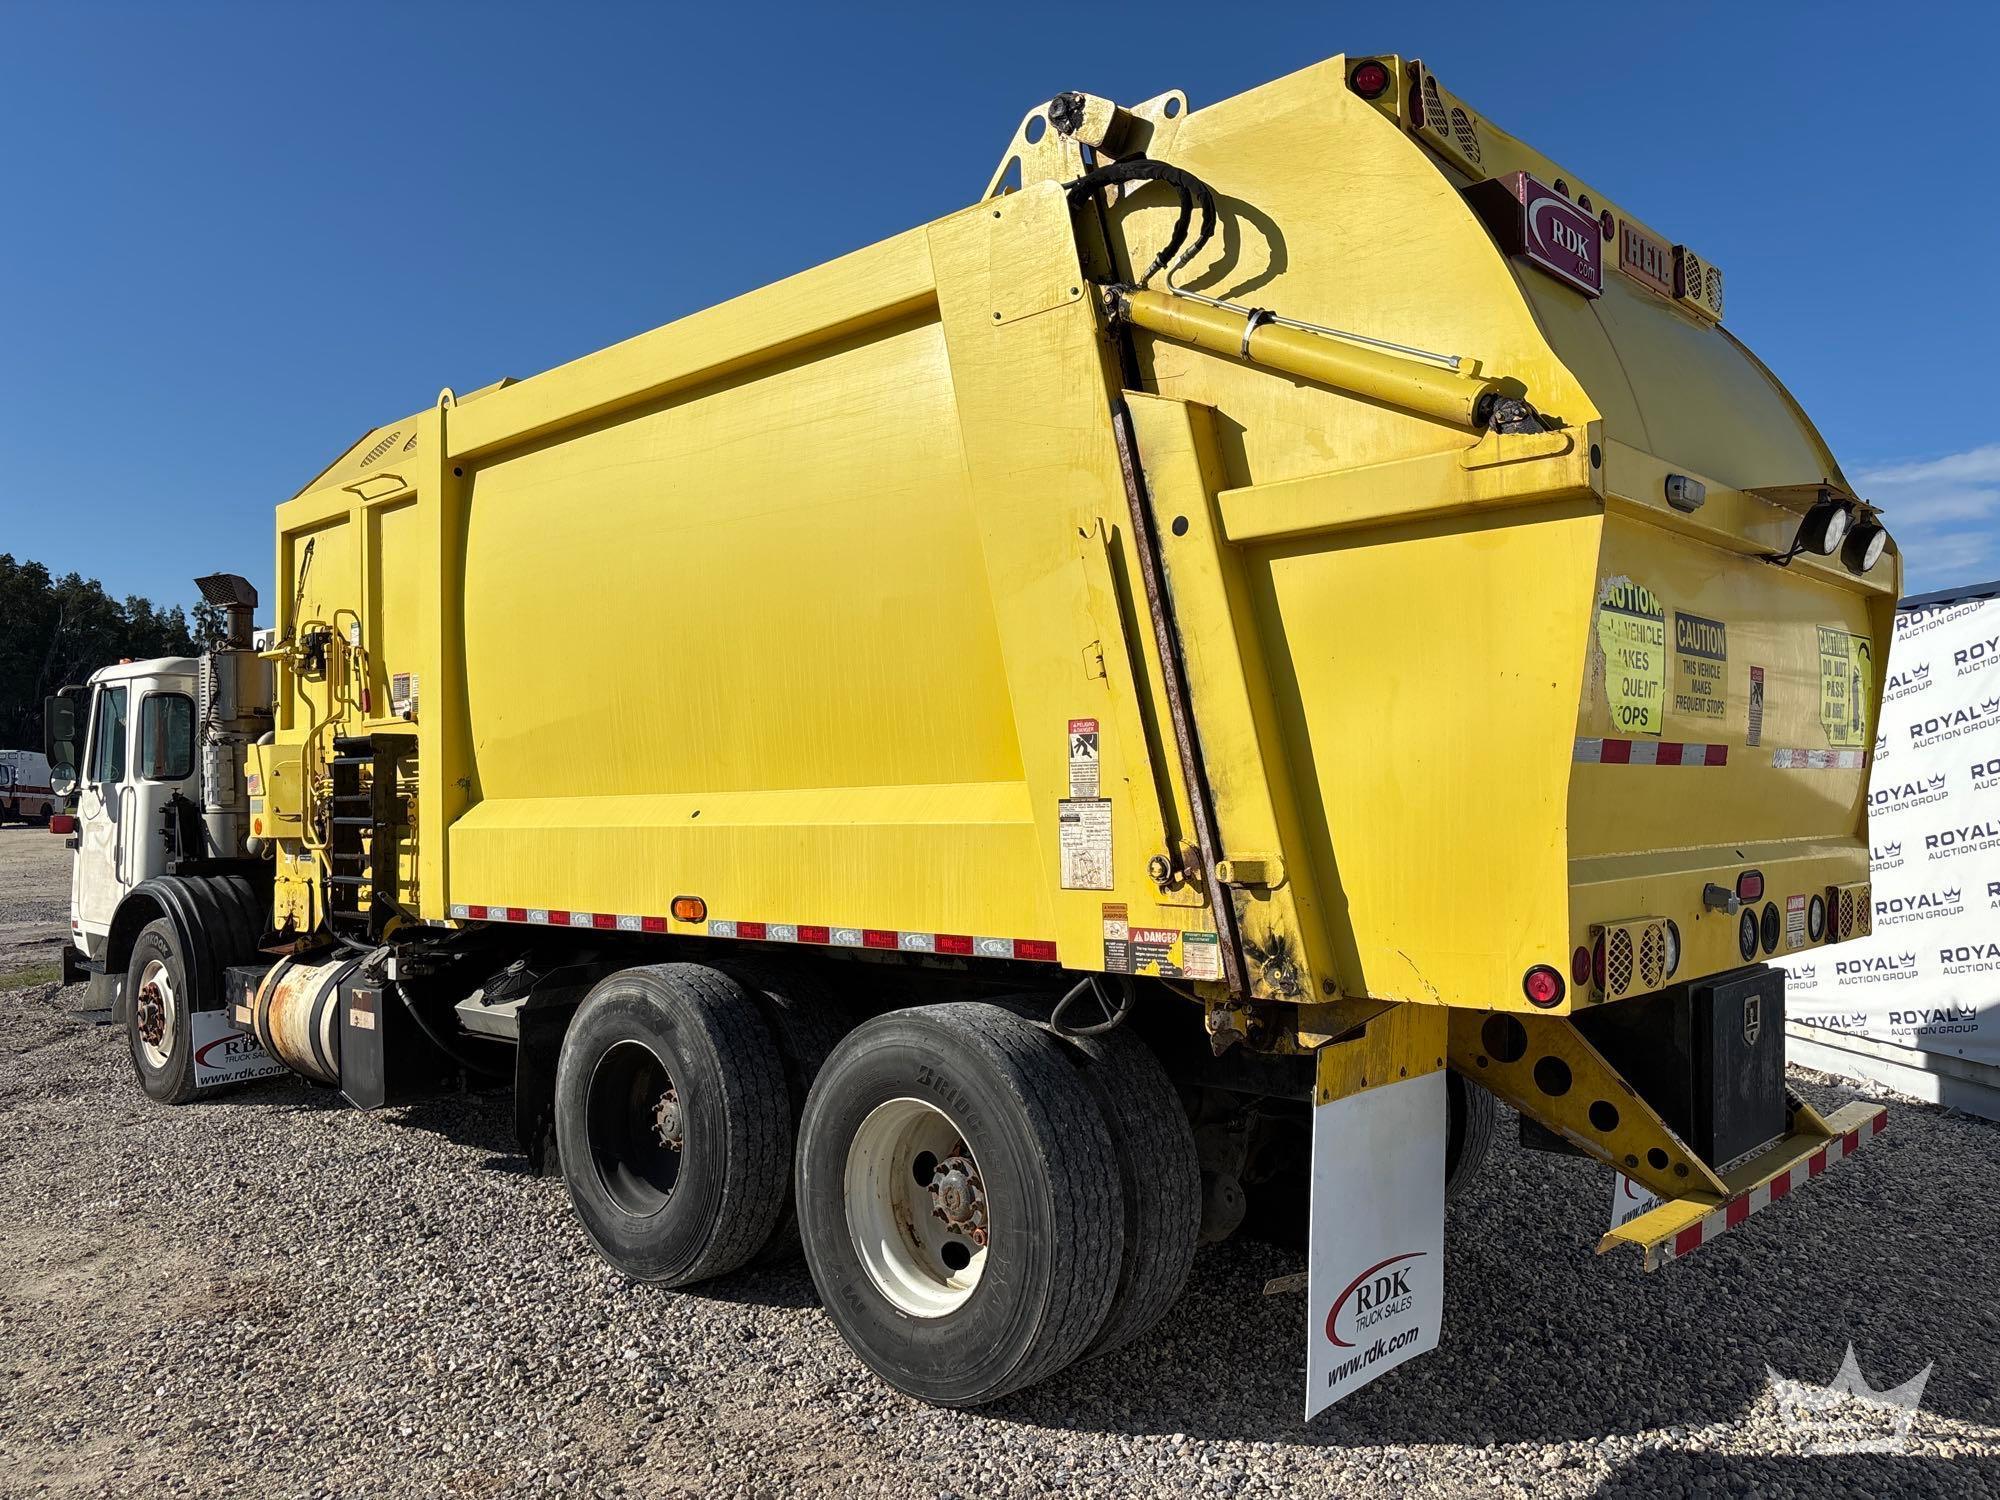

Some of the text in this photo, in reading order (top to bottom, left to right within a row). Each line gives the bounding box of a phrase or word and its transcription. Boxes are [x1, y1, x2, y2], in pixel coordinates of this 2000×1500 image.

[1552, 217, 1590, 262] RDK
[1575, 260, 1595, 281] .com
[1601, 583, 1663, 617] AUTION
[1899, 601, 1985, 641] AUCTION GROUP
[1624, 621, 1662, 646] VEHICLE
[1677, 619, 1726, 655] CAUTION
[1618, 648, 1649, 671] AKES
[1683, 659, 1721, 680] THIS VEHICLE
[1957, 655, 2000, 677] AUCTIO
[1691, 679, 1712, 695] MAKES
[1826, 681, 1845, 698] PASS
[1896, 680, 1933, 699] GROUP
[1675, 695, 1724, 714] FREQUENT STOPS
[1616, 705, 1649, 726] OPS
[1910, 706, 1981, 739] ROYAL
[1913, 728, 1960, 749] AUCTION
[1868, 791, 1948, 818] UCTION GROUP
[1925, 822, 1998, 849] ROYAL
[1928, 843, 1977, 861] AUCTION
[1870, 859, 1904, 872] GROUP
[1875, 893, 1943, 915] ROYAL
[1878, 906, 1964, 926] AUCTION GROUP
[1143, 931, 1177, 943] DANGER
[1836, 956, 1899, 975] ROYAL
[1943, 963, 1993, 975] AUCTION
[1787, 981, 1818, 991] GROUP
[1838, 971, 1919, 985] AUCTION GROUP
[1793, 1015, 1850, 1029] OYAL
[1889, 1008, 1958, 1025] ROYAL
[1891, 1024, 1979, 1036] AUCTION GROUP
[224, 1041, 264, 1056] RD
[225, 1050, 271, 1063] TRUCK SAL
[200, 1065, 285, 1085] www.rdk.com
[1355, 1267, 1412, 1317] RDK
[1356, 1296, 1412, 1334] TRUCK SALES
[1328, 1326, 1419, 1388] www.rdk.com
